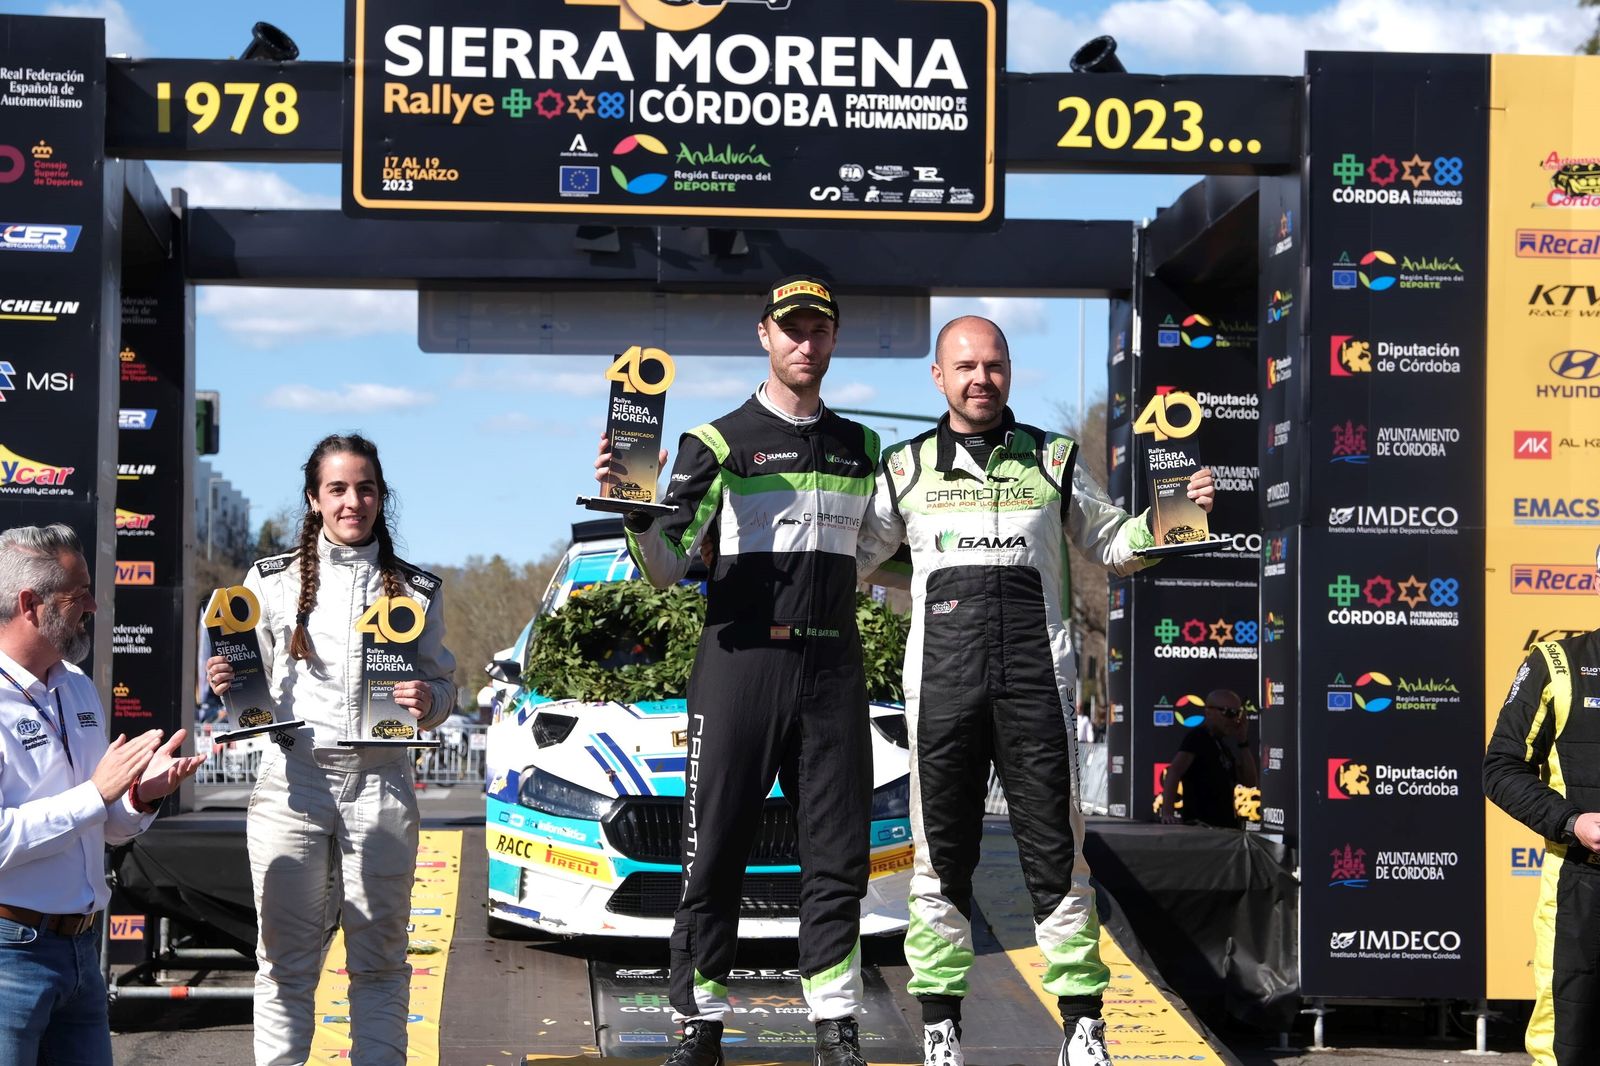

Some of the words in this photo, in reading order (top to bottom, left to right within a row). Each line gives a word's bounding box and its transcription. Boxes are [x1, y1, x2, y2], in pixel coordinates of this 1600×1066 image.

[384, 24, 635, 81] SIERRA
[655, 32, 968, 89] MORENA
[0, 68, 22, 80] Real
[26, 68, 84, 82] Federación
[10, 81, 58, 96] Española
[61, 83, 74, 94] de
[0, 94, 82, 108] Automovilismo
[158, 82, 300, 134] 1978
[384, 82, 494, 124] Rallye
[639, 84, 838, 127] CÓRDOBA
[846, 94, 954, 112] PATRIMONIO
[846, 111, 968, 131] HUMANIDAD
[674, 142, 772, 168] Andalucía
[384, 156, 398, 169] 17
[402, 157, 420, 169] AL
[425, 158, 440, 170] 19
[383, 168, 402, 180] DE
[406, 169, 459, 182] MARZO
[674, 171, 708, 181] Región
[712, 172, 756, 183] Europea
[758, 172, 772, 181] del
[46, 178, 83, 187] Deportes
[382, 180, 414, 192] 2023
[674, 182, 736, 192] DEPORTE
[1332, 186, 1411, 204] CÓRDOBA
[1413, 197, 1462, 205] HUMANIDAD
[1400, 256, 1464, 272] Andalucía
[1400, 274, 1422, 282] Región
[1424, 274, 1452, 282] Europea
[0, 300, 80, 314] CHELIN
[1528, 309, 1572, 318] RACE
[1378, 342, 1460, 358] Diputación
[605, 346, 676, 395] 40
[1377, 358, 1396, 372] de
[1400, 358, 1460, 373] Córdoba
[1198, 392, 1258, 406] Diputació
[613, 404, 650, 416] SIERRA
[1216, 406, 1260, 420] Córdob
[612, 412, 658, 424] MORENA
[1133, 394, 1202, 442] 40
[621, 430, 654, 438] CLASIFICADO
[1377, 428, 1460, 442] AYUNTAMIENTO
[1377, 442, 1390, 456] DE
[1393, 440, 1446, 456] CÓRDOBA
[1518, 437, 1548, 454] AK
[767, 452, 798, 460] SUMACO
[1149, 452, 1186, 462] SIERRA
[118, 464, 156, 474] ELIN
[1150, 458, 1196, 470] MORENA
[926, 488, 1034, 502] CARMOTIVE
[926, 501, 956, 510] PASIÓN
[1358, 506, 1458, 527] IMDECO
[1356, 527, 1388, 535] Municipal
[1399, 528, 1430, 536] Deportes
[958, 537, 1028, 549] GAMA
[412, 575, 435, 591] OMP
[202, 586, 260, 636] 40
[1328, 608, 1408, 625] CÓRDOBA
[354, 595, 426, 644] 40
[1410, 618, 1459, 626] HUMANIDAD
[216, 644, 248, 656] SIERRA
[226, 651, 257, 662] ORENA
[1154, 644, 1218, 659] CÓRDOBA
[366, 654, 404, 663] SIERRA
[1545, 644, 1568, 676] Sabelt
[366, 662, 414, 672] MORENA
[1398, 676, 1460, 694] Andalucía
[1420, 696, 1448, 704] Europea
[1376, 765, 1458, 782] Diputación
[1376, 782, 1393, 795] de
[1398, 782, 1458, 796] Córdoba
[496, 834, 532, 858] RACC
[546, 849, 598, 876] PIRELLI
[872, 850, 914, 873] IRELLI
[1376, 852, 1458, 866] AYUNTAMIENTO
[1376, 866, 1390, 880] DE
[1392, 864, 1444, 880] CÓRDOBA
[1360, 930, 1461, 951] IMDECO
[1358, 952, 1390, 960] Municipal
[1402, 952, 1432, 960] Deportes
[1432, 952, 1460, 960] Córdoba
